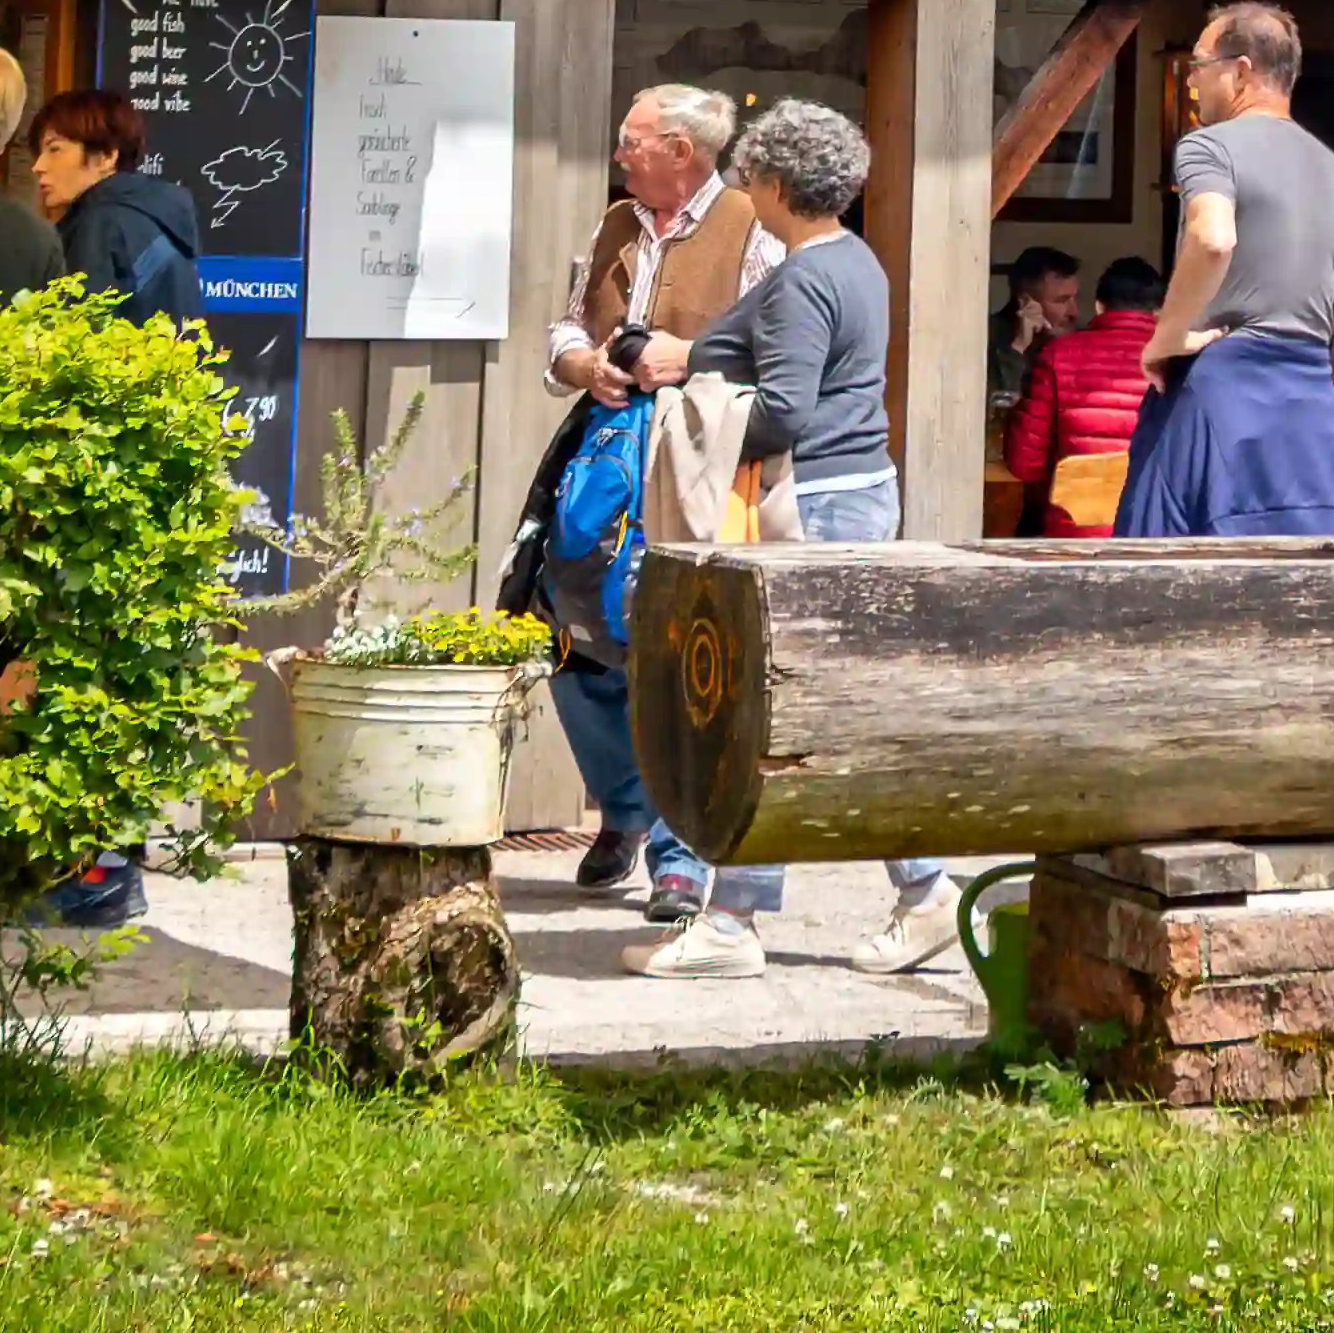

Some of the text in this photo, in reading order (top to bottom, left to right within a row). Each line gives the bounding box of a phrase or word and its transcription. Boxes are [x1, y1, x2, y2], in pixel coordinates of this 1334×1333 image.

[130, 10, 186, 37] good fish
[129, 36, 159, 64] good
[129, 64, 159, 89] good
[204, 279, 298, 299] MÜNCHEN
